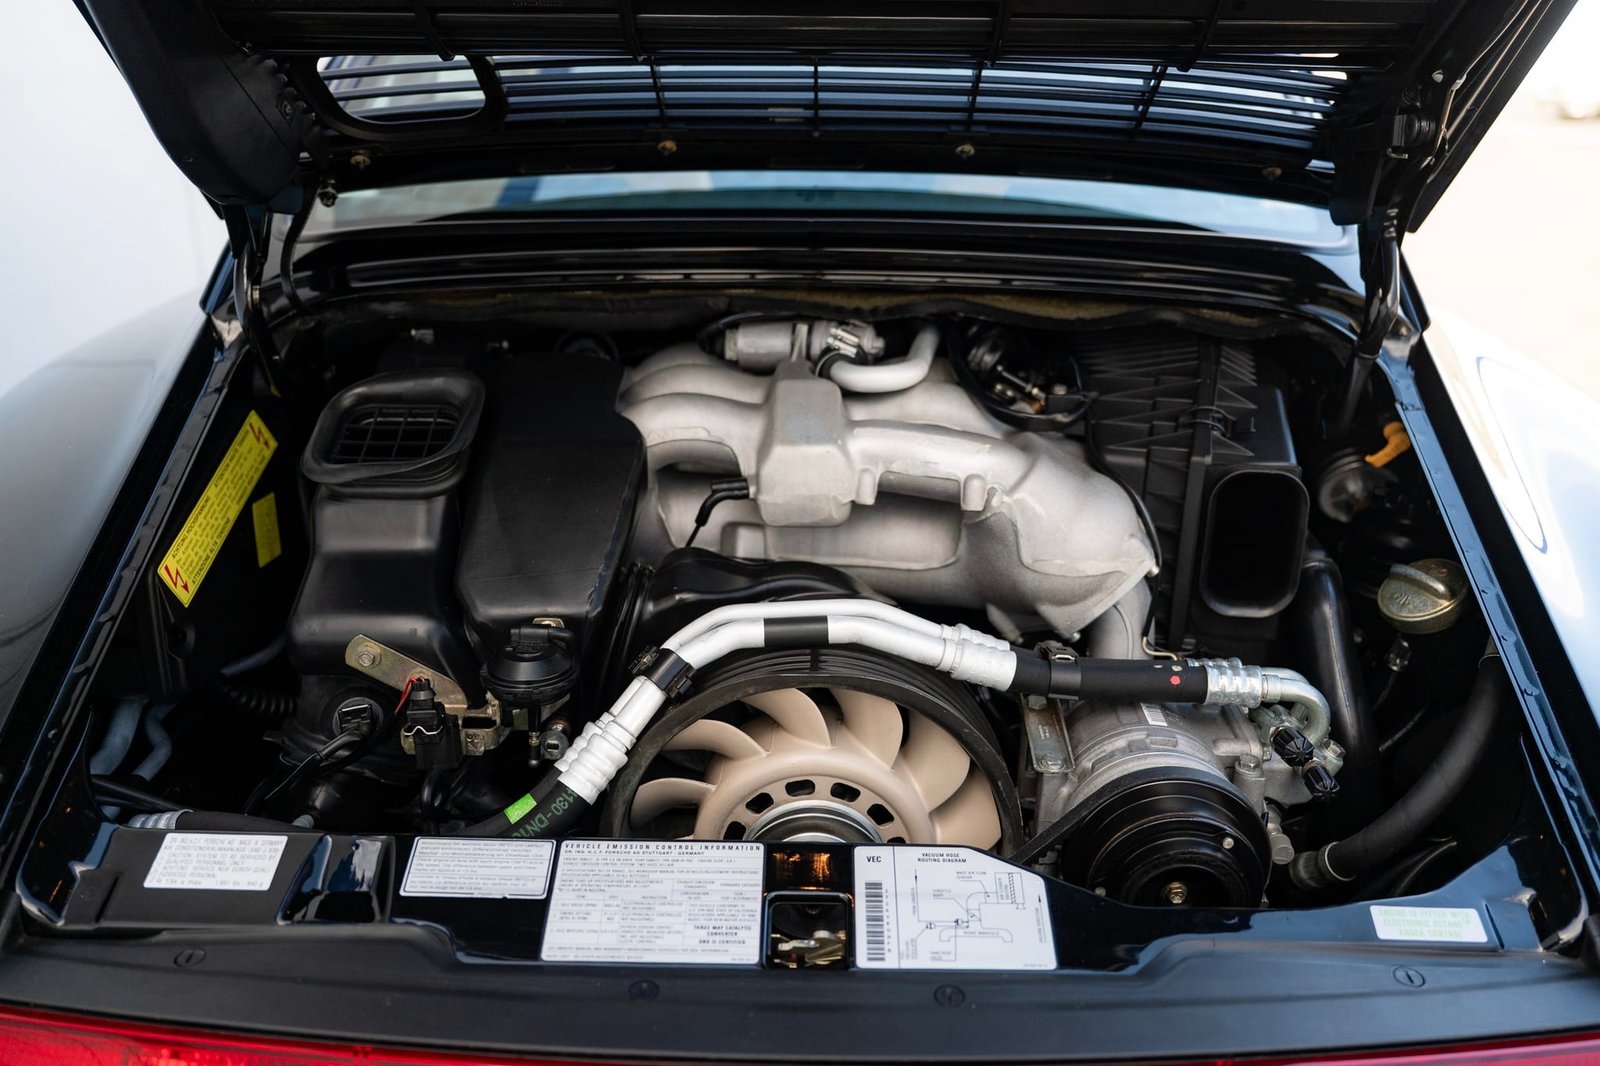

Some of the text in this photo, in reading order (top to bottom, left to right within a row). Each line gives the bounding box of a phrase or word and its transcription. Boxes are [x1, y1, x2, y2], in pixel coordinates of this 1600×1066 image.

[172, 534, 186, 559] ACHTUNG
[192, 518, 231, 584] ATTENZIONE ALTA TENSIONE
